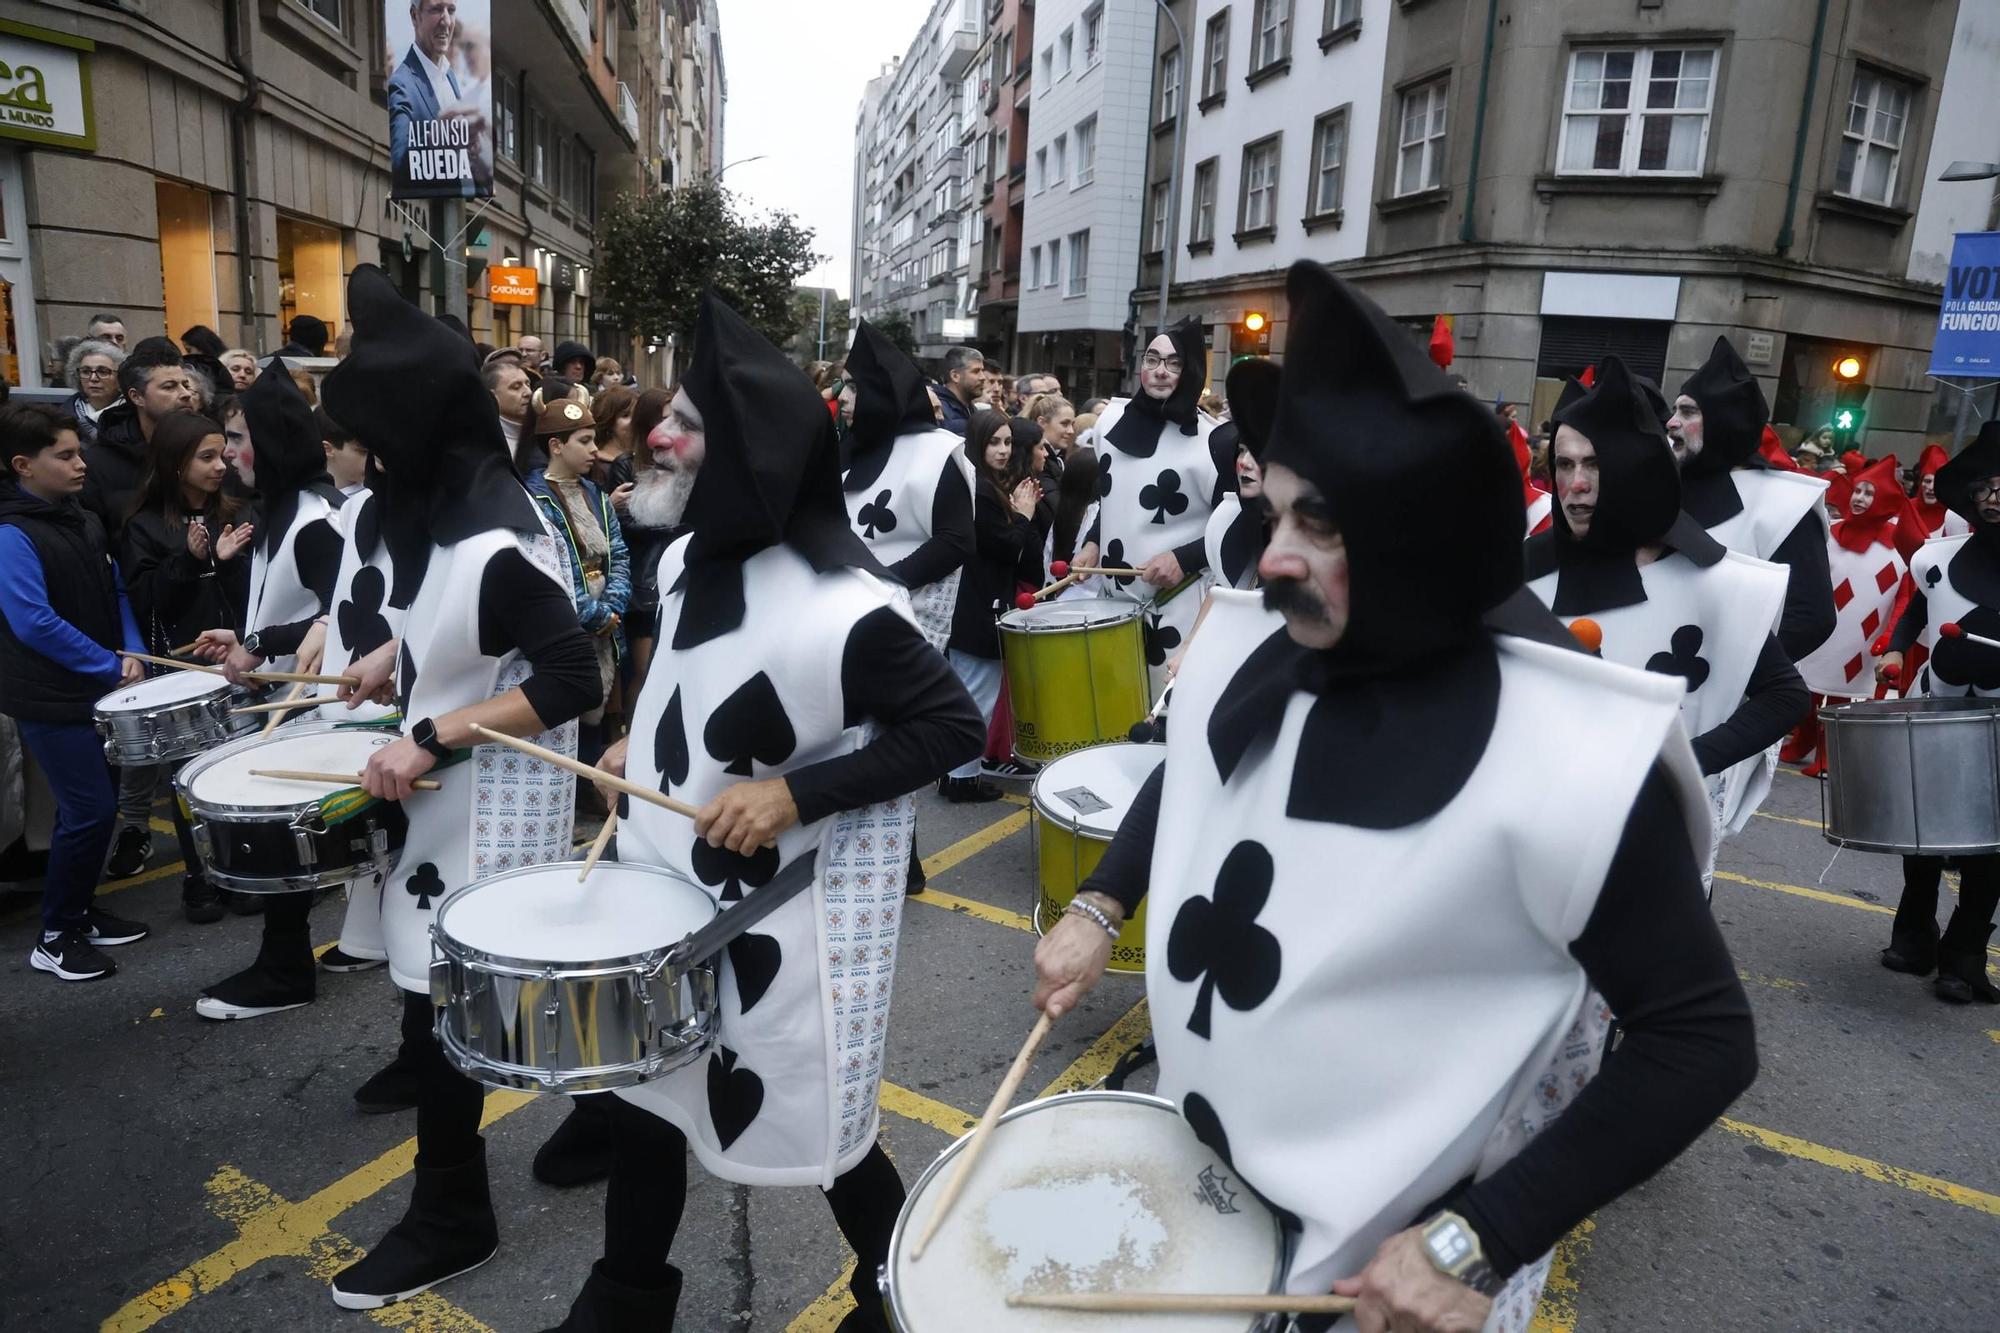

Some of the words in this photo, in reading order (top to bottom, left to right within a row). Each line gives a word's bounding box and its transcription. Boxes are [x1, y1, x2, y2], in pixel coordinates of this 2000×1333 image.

[8, 109, 54, 128] MUNDO
[408, 119, 470, 147] ALFONSO
[408, 148, 472, 180] RUEDA
[491, 285, 534, 296] CATCHALOT
[1945, 301, 1966, 311] POLA
[1968, 301, 2000, 311] GALICI
[1941, 313, 2000, 331] FUNCIO
[1202, 1174, 1229, 1210] REMO
